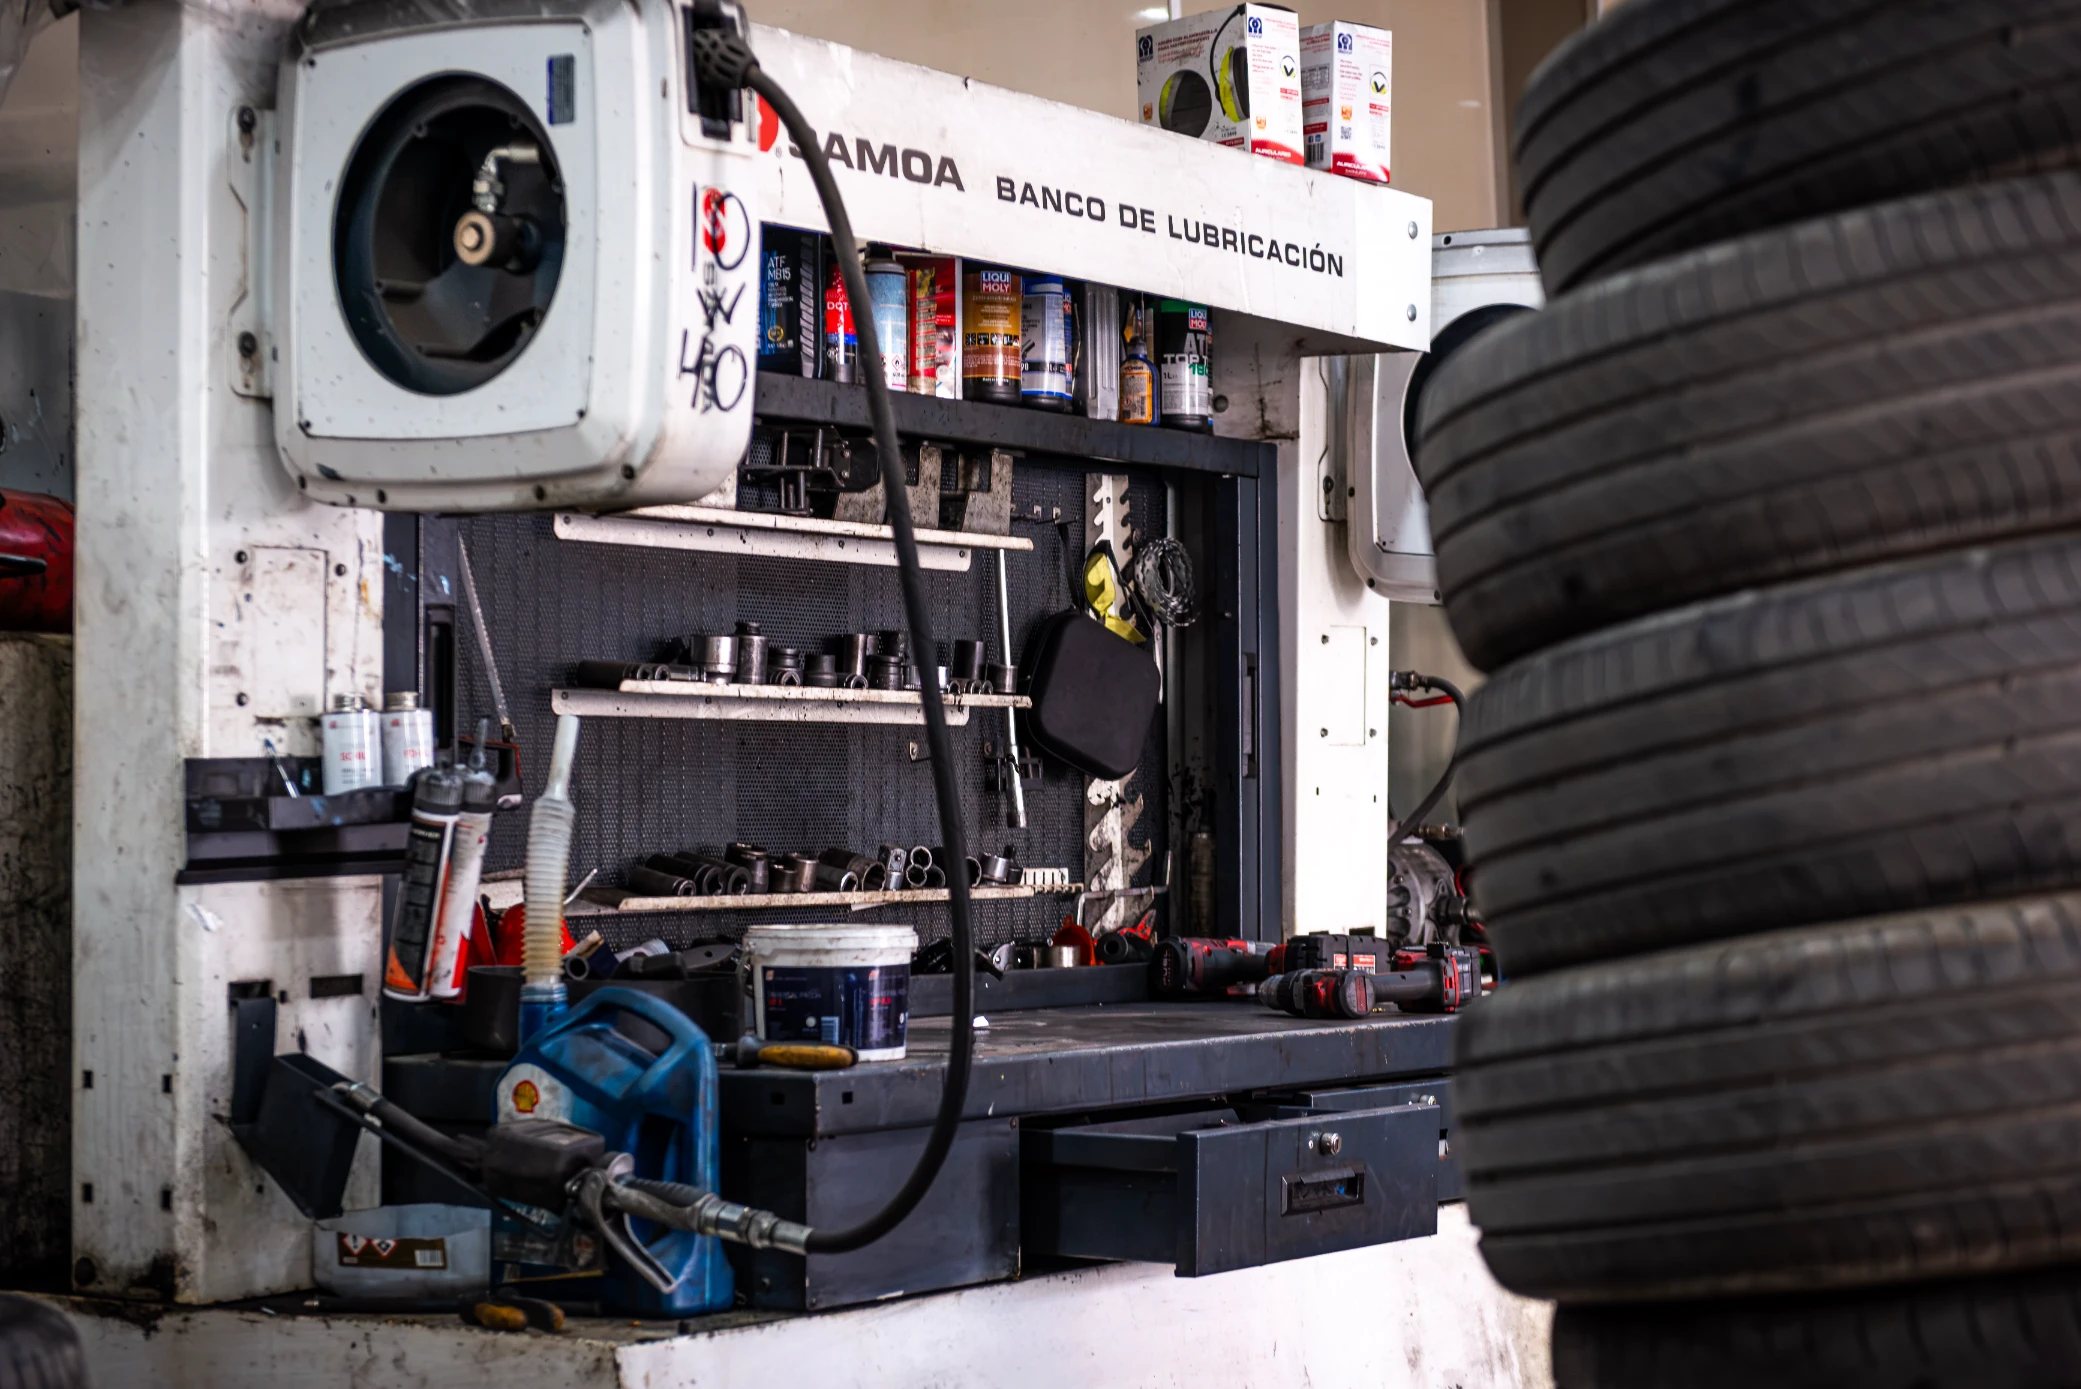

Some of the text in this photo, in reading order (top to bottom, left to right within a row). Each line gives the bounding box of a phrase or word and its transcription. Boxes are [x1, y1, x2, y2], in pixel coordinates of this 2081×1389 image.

[996, 175, 1344, 277] BANCO DE LUBRICACIÓN
[768, 255, 786, 268] ATF
[982, 272, 1010, 282] LIQUI
[982, 283, 1010, 293] MOLY
[827, 301, 849, 311] DOT
[1163, 353, 1200, 366] TOP
